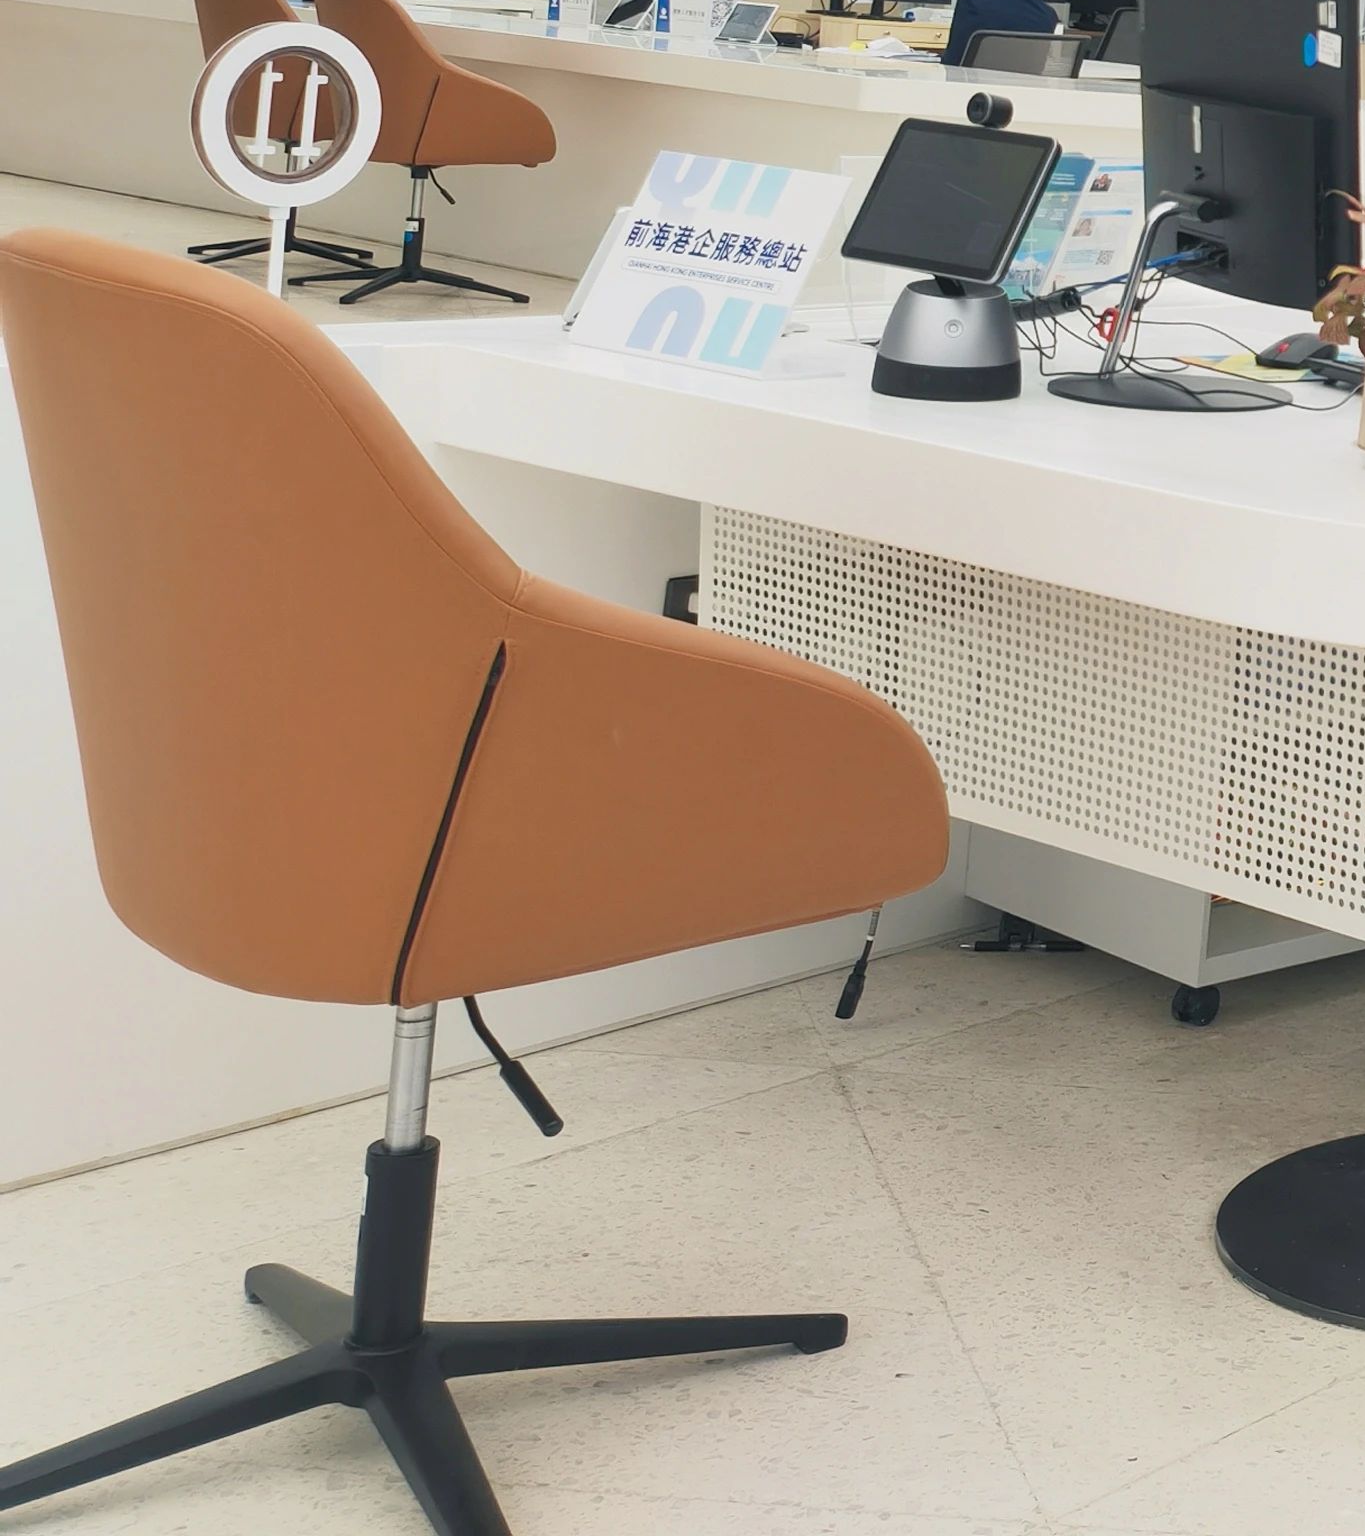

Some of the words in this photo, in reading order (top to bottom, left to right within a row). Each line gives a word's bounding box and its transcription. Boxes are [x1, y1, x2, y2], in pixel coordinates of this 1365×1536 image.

[624, 218, 808, 272] 前海港企服務總站
